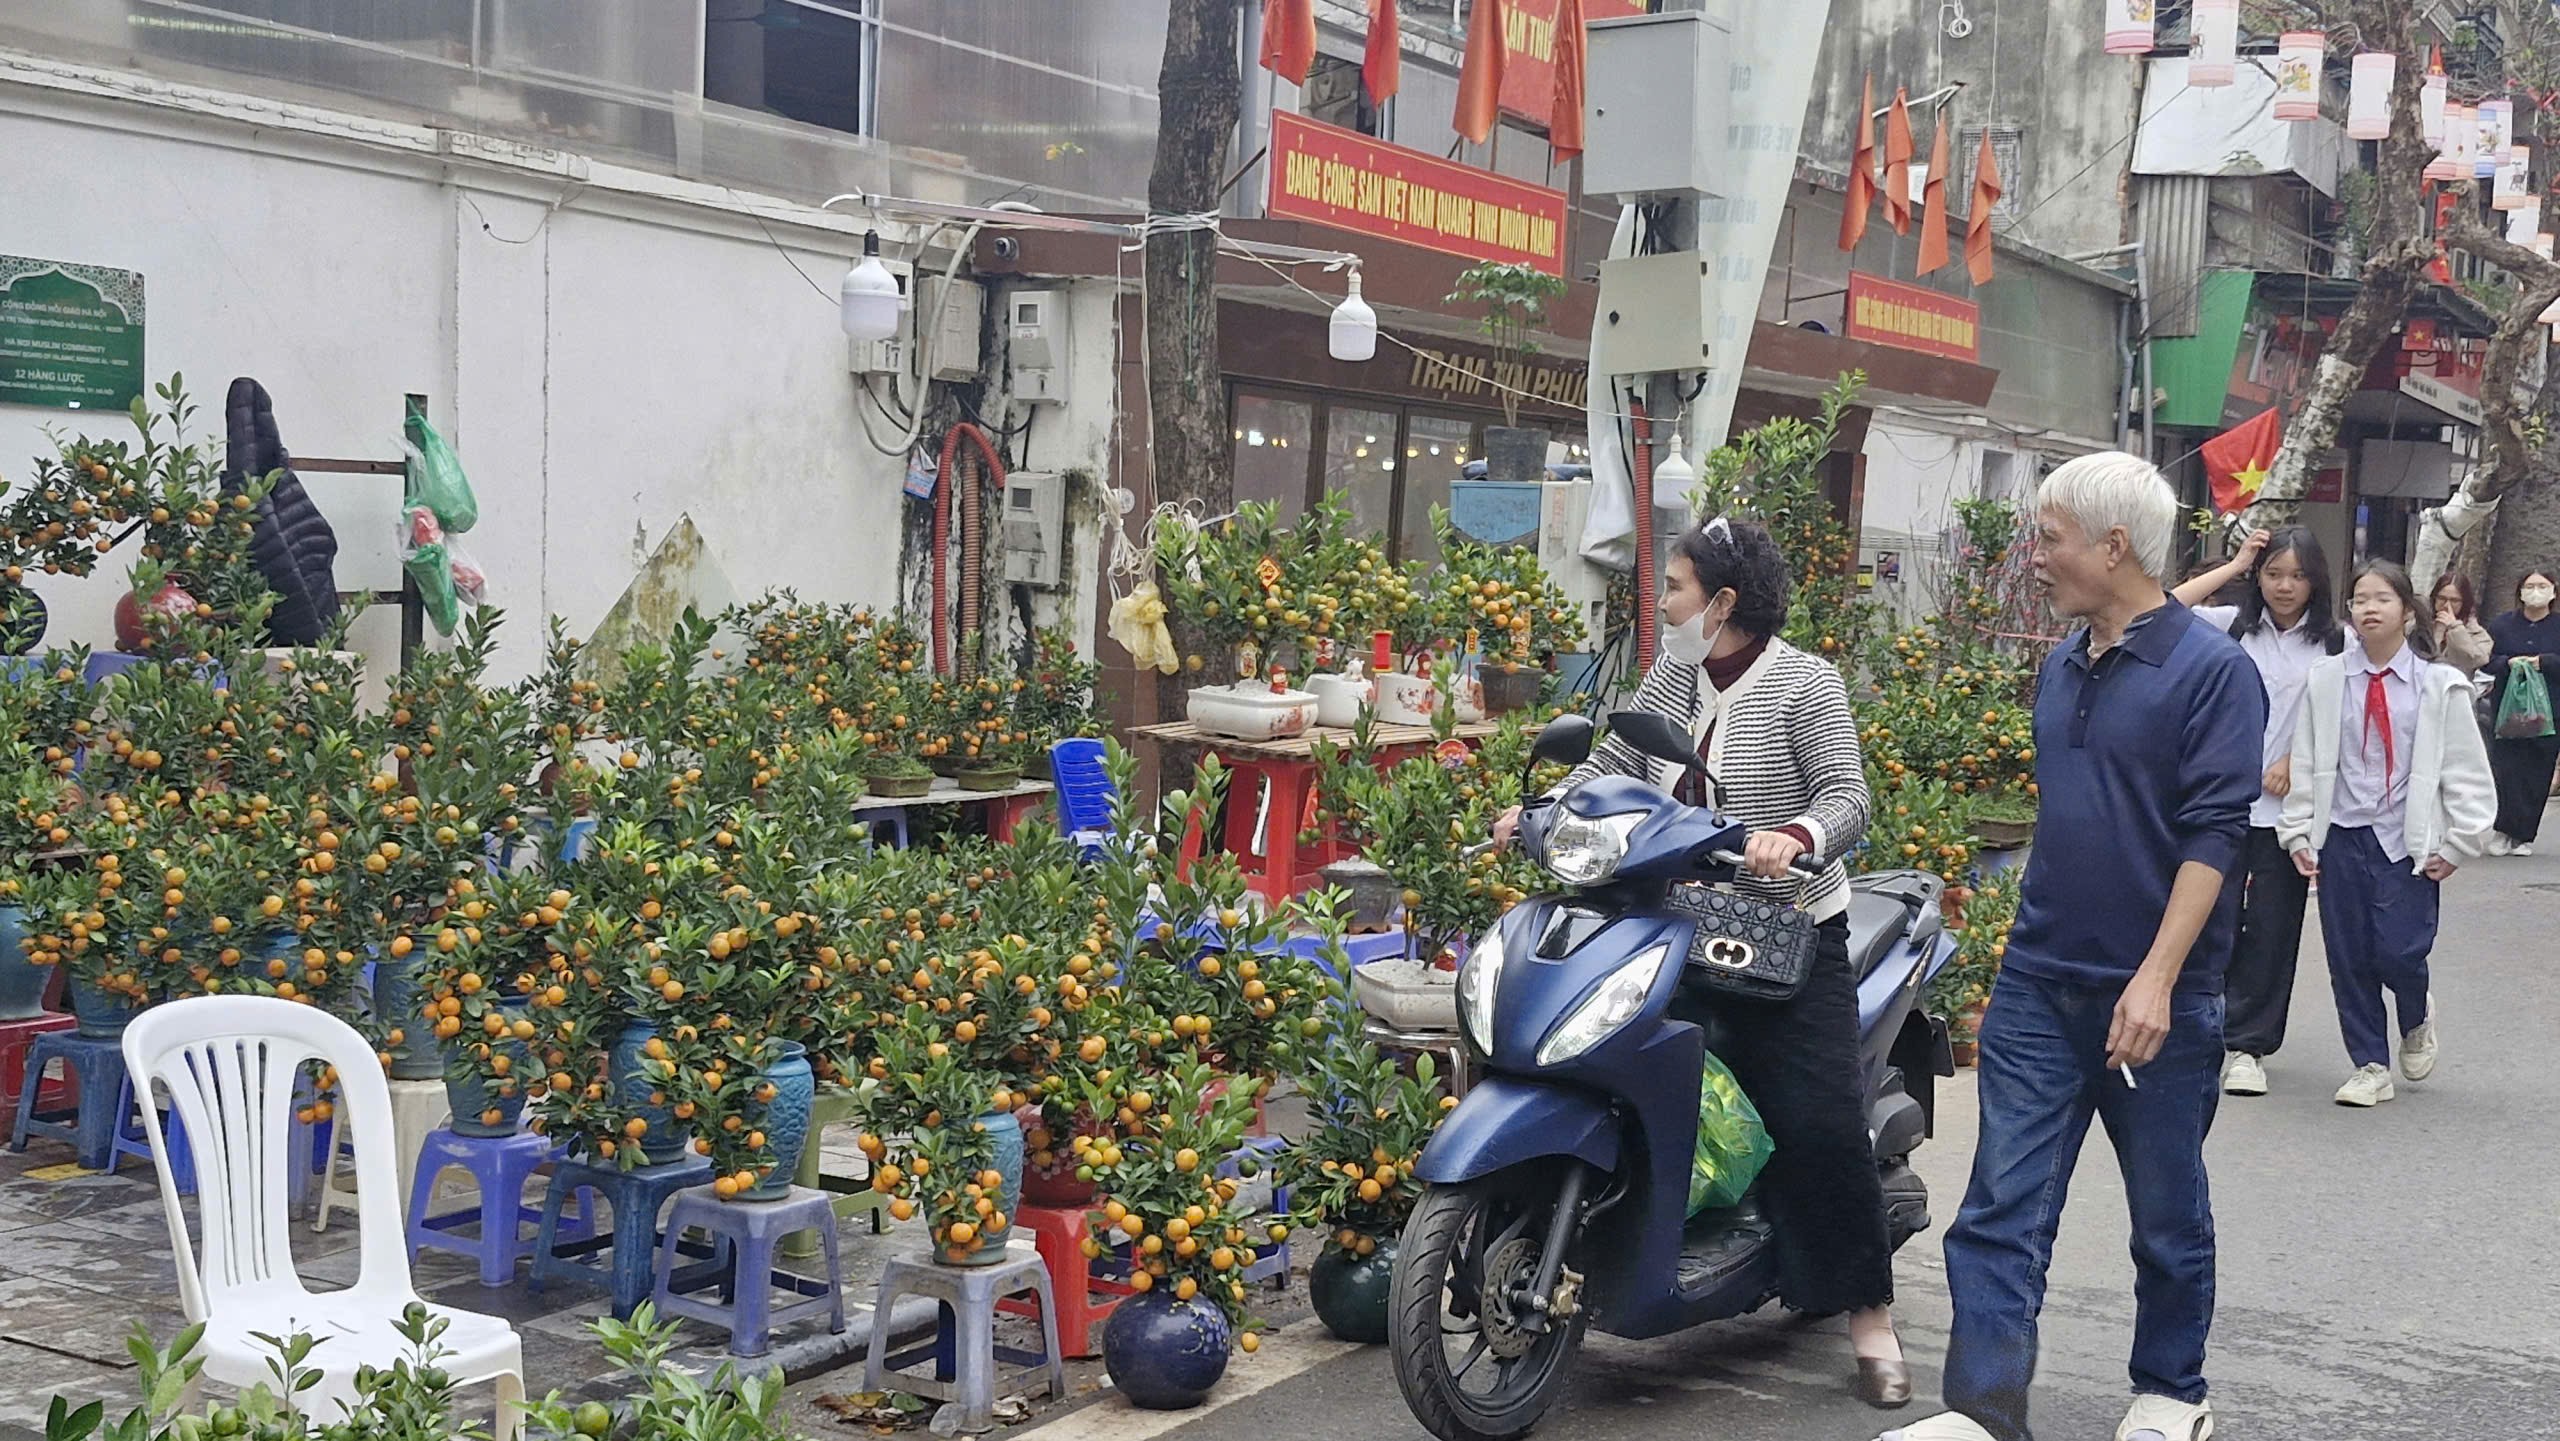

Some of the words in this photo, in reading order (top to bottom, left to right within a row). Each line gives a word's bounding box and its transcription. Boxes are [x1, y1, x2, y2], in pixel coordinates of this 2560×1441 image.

[1286, 133, 1320, 201] ĐẢNG
[1322, 153, 1356, 216] CỘNG
[1357, 154, 1382, 217] SẢN
[1384, 171, 1408, 231] VIỆT
[1409, 183, 1435, 230] NAM
[1437, 191, 1473, 238] QUANG
[1474, 201, 1499, 245] VINH
[1500, 203, 1529, 252] MUÔN
[1530, 209, 1556, 259] NĂM!
[32, 340, 61, 349] MUSLIM
[62, 342, 106, 354] COMMUNITY
[15, 369, 26, 379] 12
[28, 368, 56, 381] HÀNG
[57, 372, 85, 386] LƯỢC
